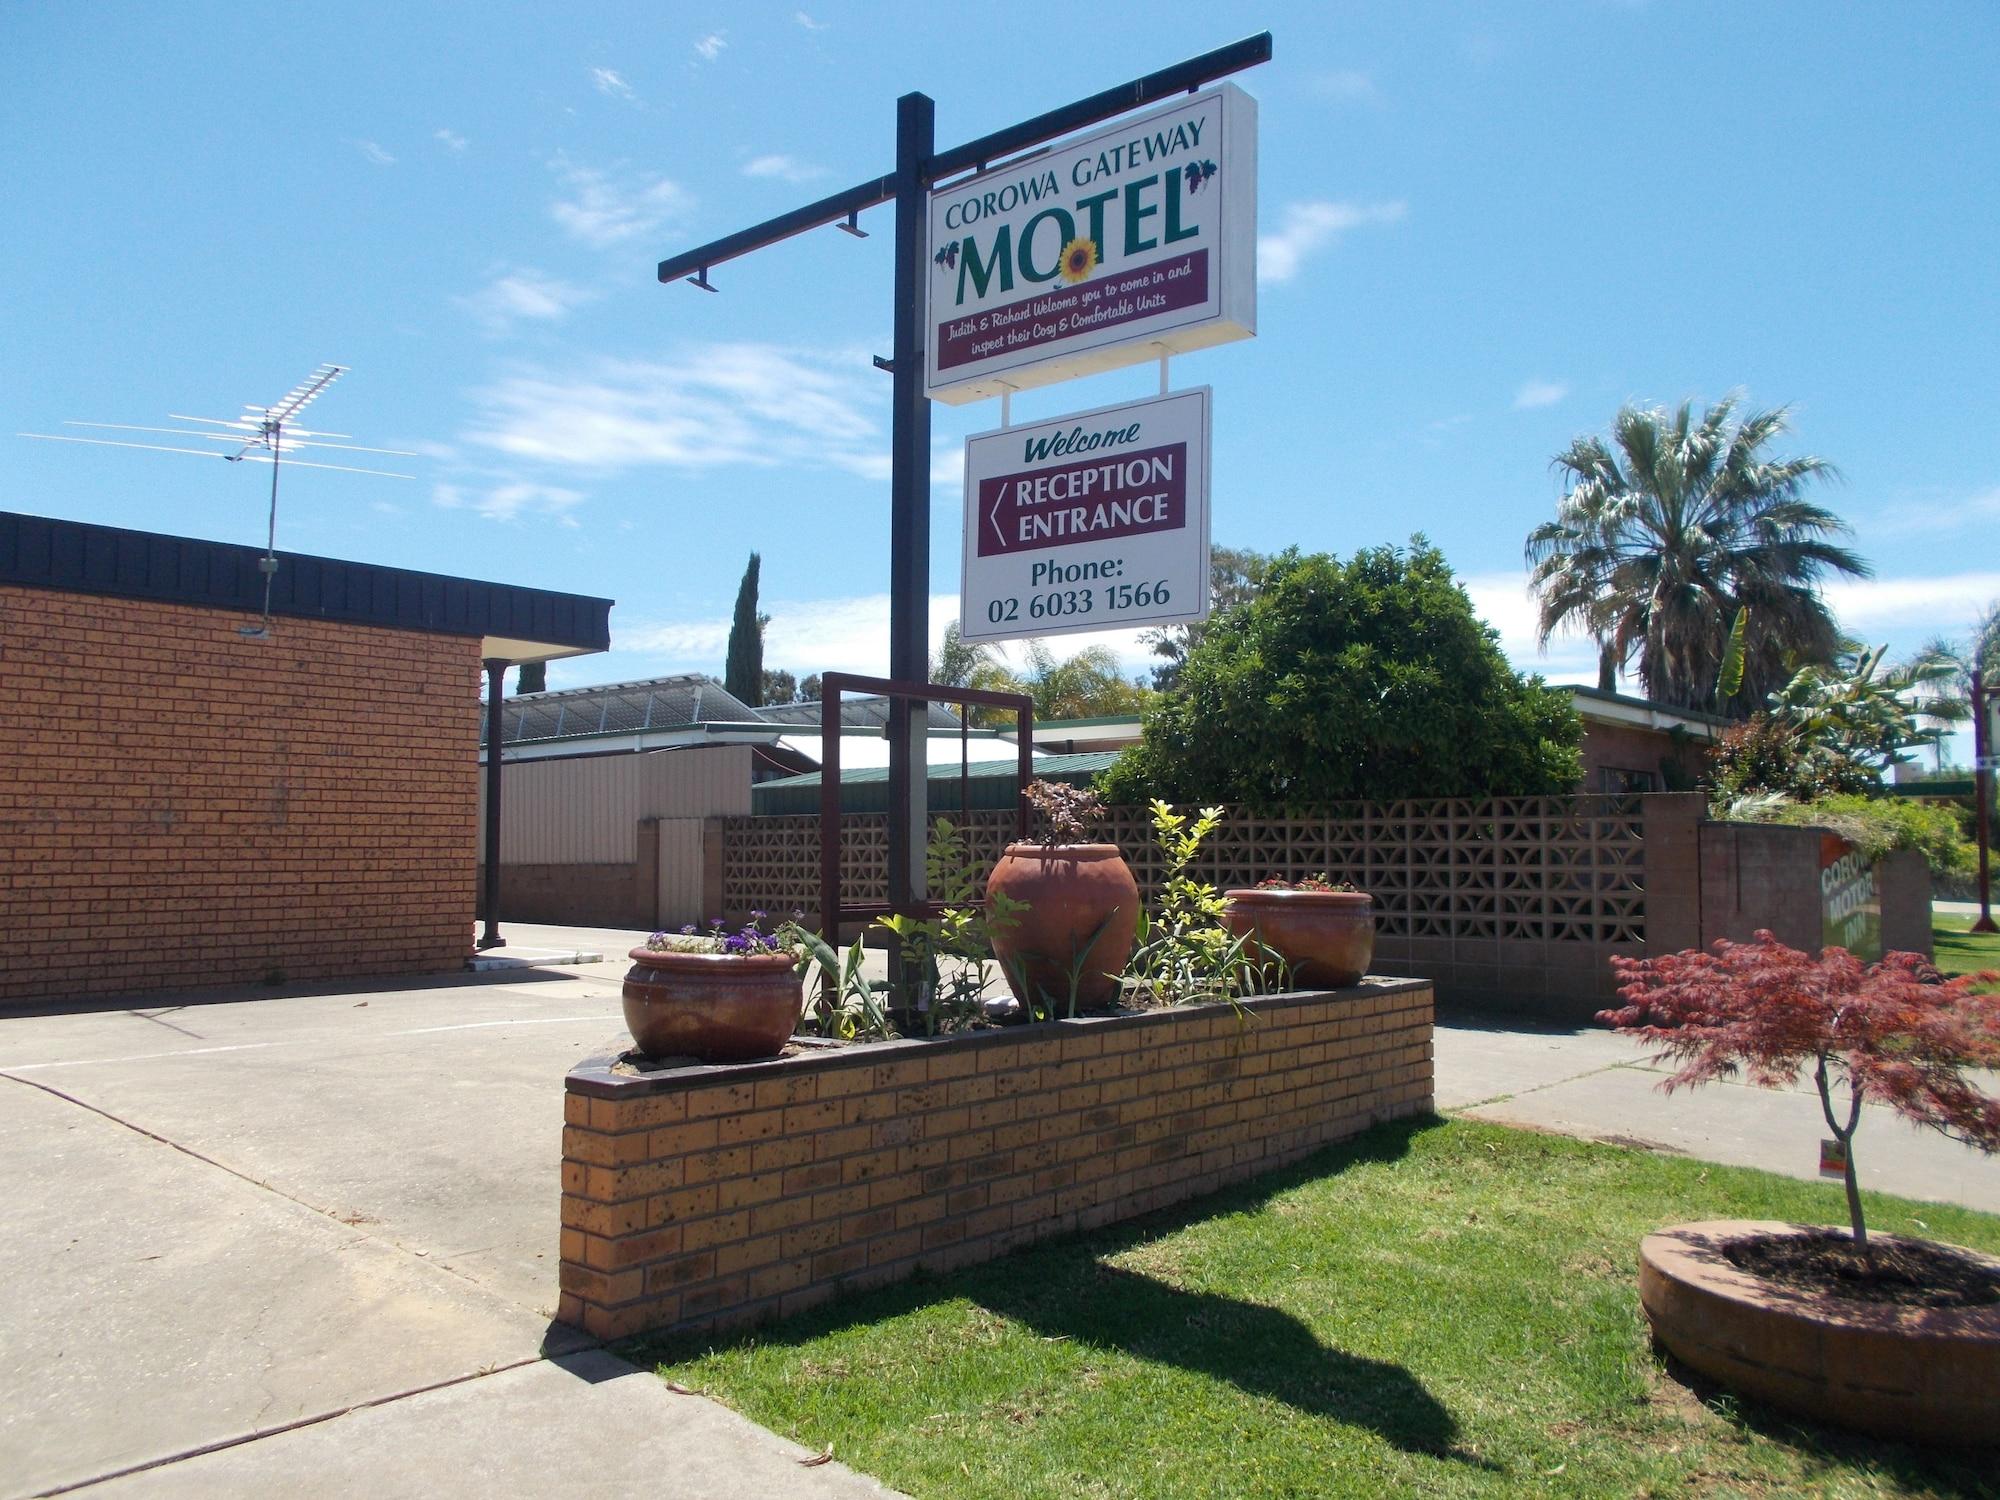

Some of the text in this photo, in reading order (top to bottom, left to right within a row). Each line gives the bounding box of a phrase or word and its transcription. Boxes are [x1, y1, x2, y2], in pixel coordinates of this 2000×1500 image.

[945, 116, 1206, 230] COROWA GATEWAY
[956, 166, 1199, 306] MOTEL
[947, 258, 1192, 342] Judith & Richard Welcome you to come in and
[971, 293, 1166, 358] inspect their Cosy & Comfortable Units
[1024, 423, 1141, 463] Welcome
[1016, 454, 1173, 507] RECEPTION
[1018, 493, 1168, 542] ENTRANCE
[1031, 558, 1123, 587] Phone:
[988, 579, 1170, 624] 02 6033 1566
[1830, 871, 1874, 927] MOTOR
[1844, 911, 1867, 950] INN
